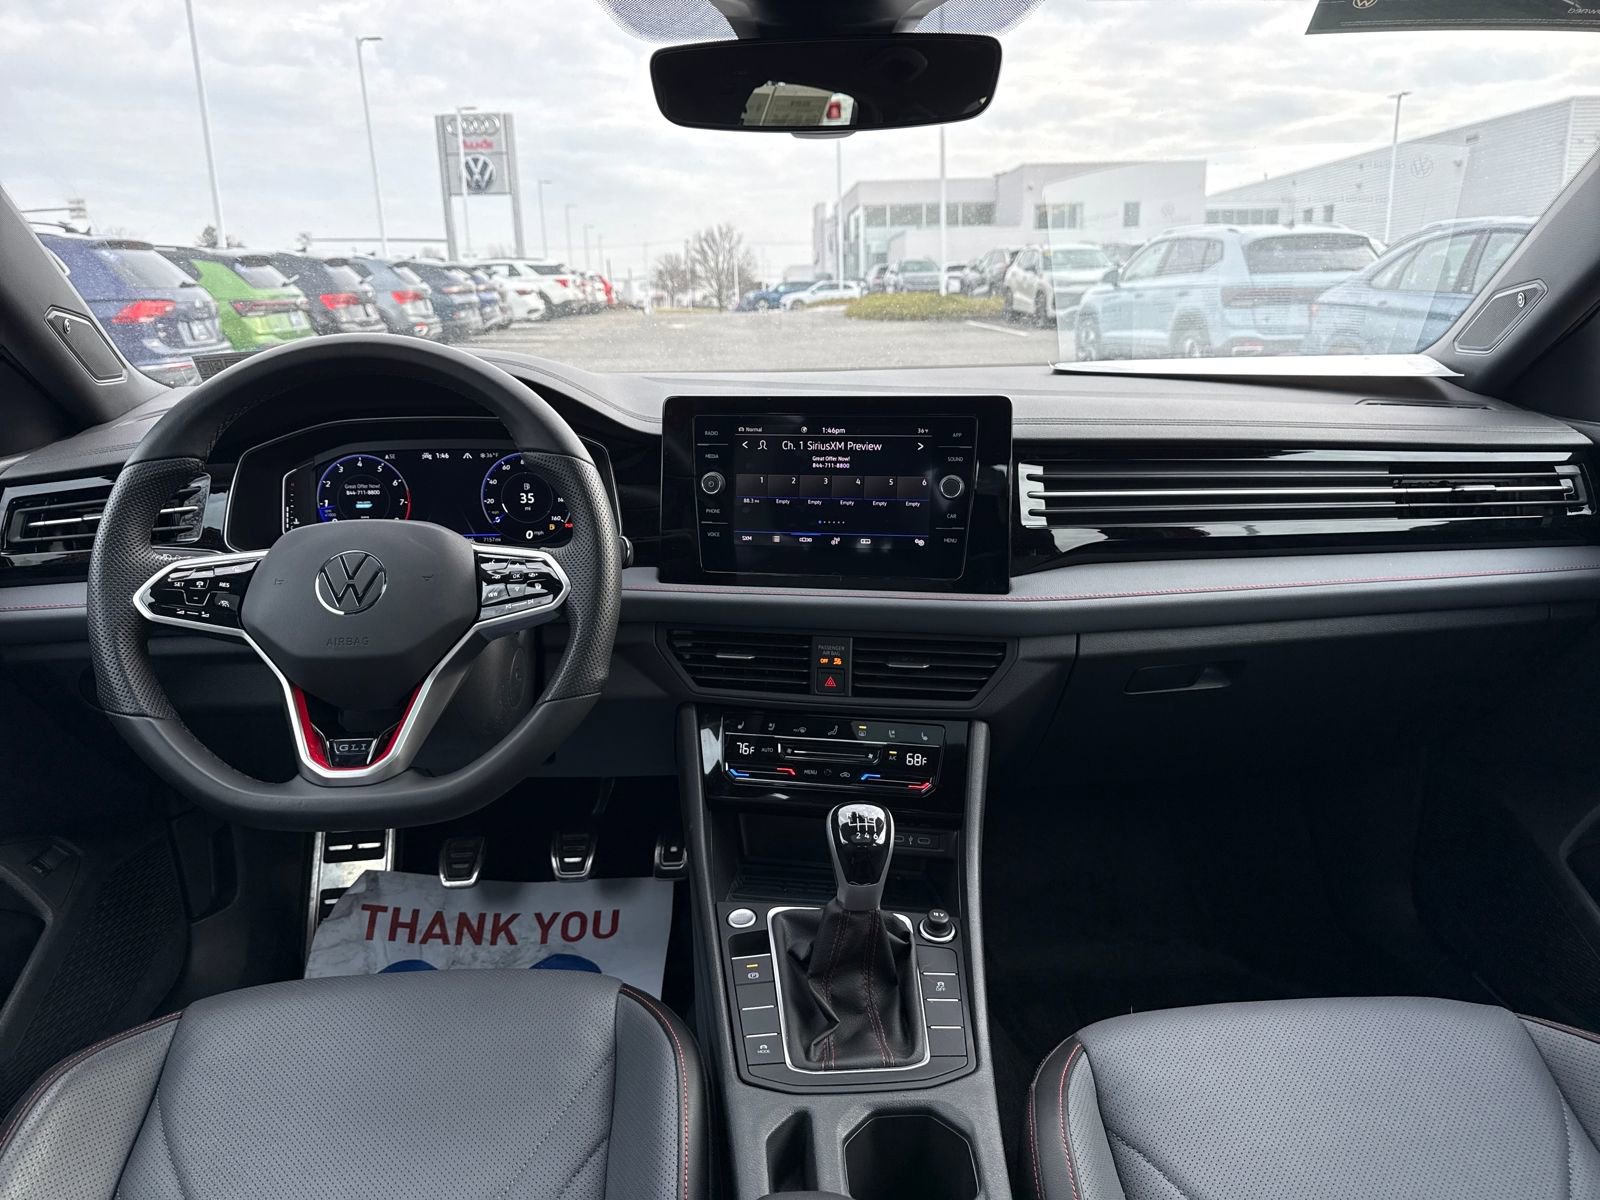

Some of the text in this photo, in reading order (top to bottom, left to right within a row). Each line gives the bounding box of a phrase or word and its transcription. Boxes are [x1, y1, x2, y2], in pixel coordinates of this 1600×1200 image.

[822, 427, 846, 435] 1:46pm
[782, 440, 882, 451] Ch. 1 SiriusXM Preview
[520, 492, 535, 504] 35
[526, 530, 534, 540] 0
[326, 637, 370, 646] AIRBAG
[361, 904, 621, 946] THANK YOU
